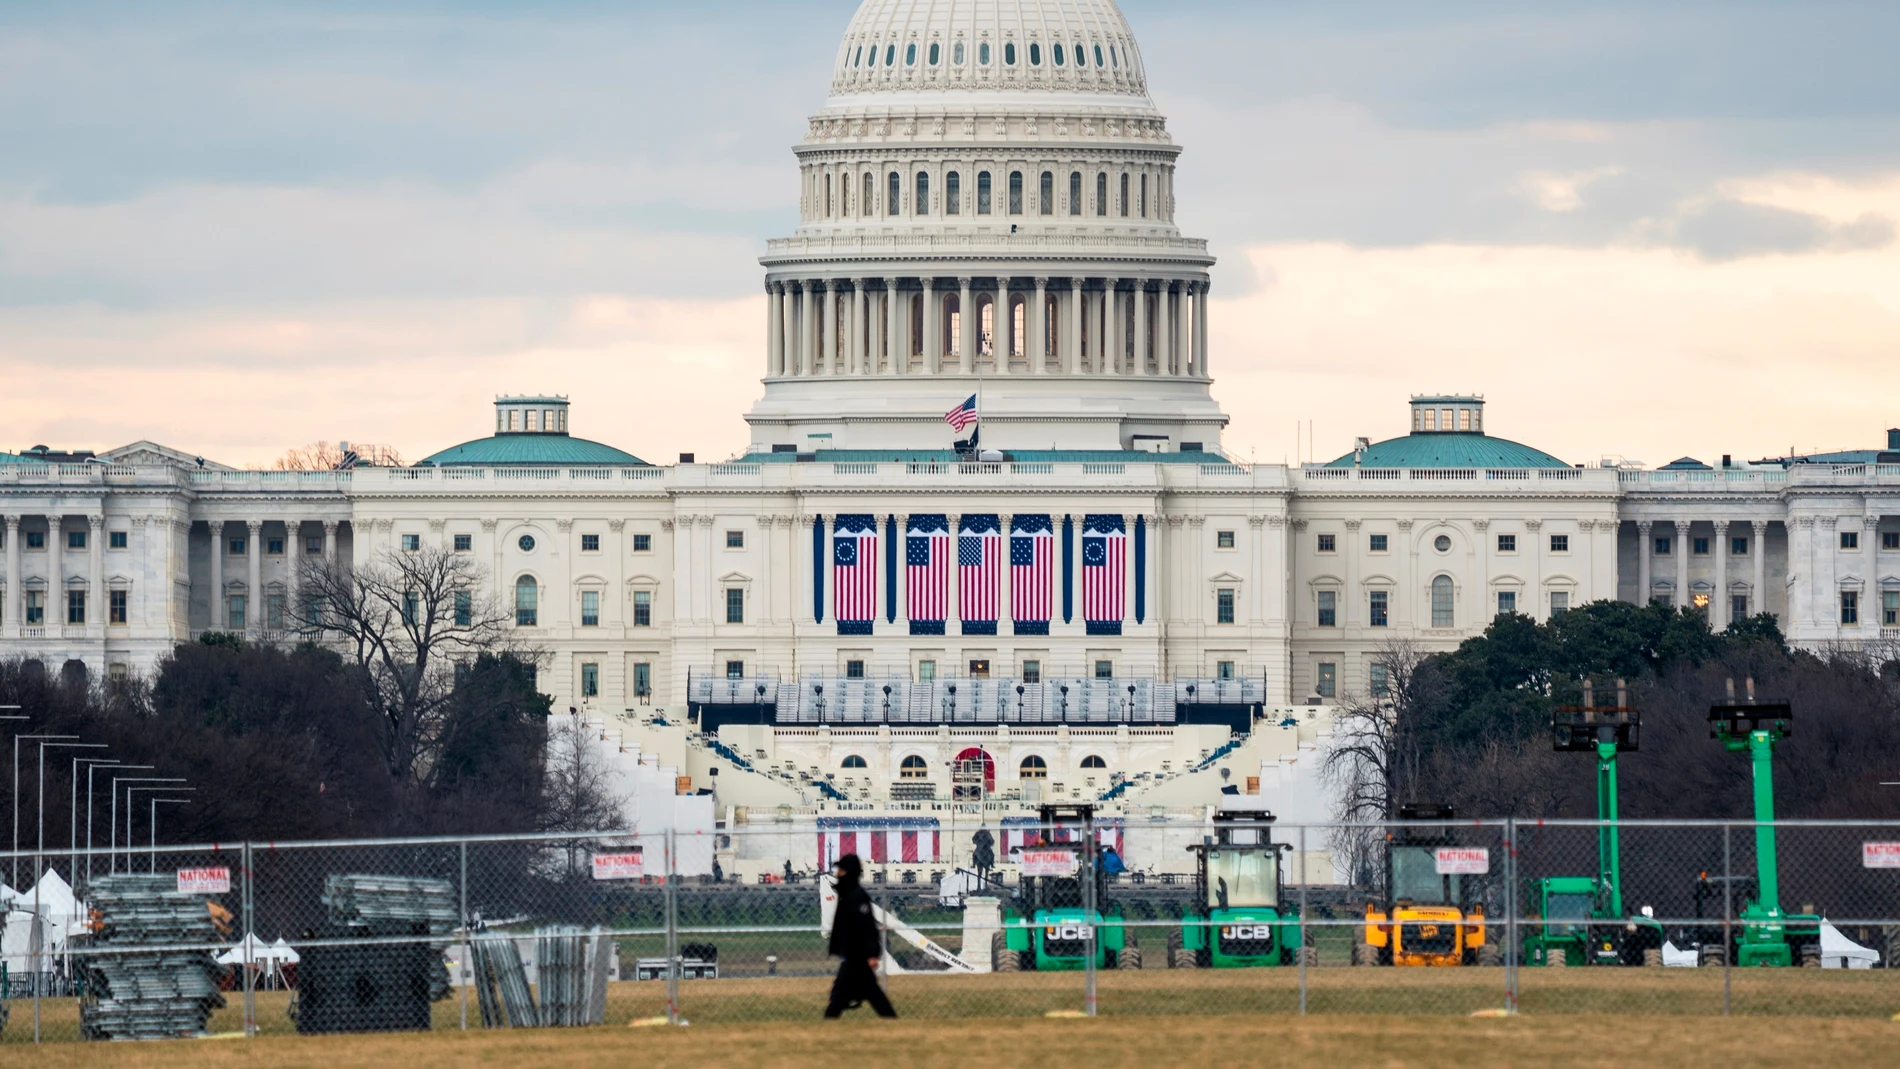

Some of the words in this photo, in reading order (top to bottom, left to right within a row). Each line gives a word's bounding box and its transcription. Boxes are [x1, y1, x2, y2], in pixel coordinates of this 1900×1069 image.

[594, 855, 642, 867] NATIONAL
[1024, 851, 1072, 863] NATIONAL
[1439, 850, 1486, 862] NATIONAL
[180, 869, 228, 881] NATIONAL
[1047, 926, 1094, 940] JCB
[1223, 925, 1270, 940] JCB
